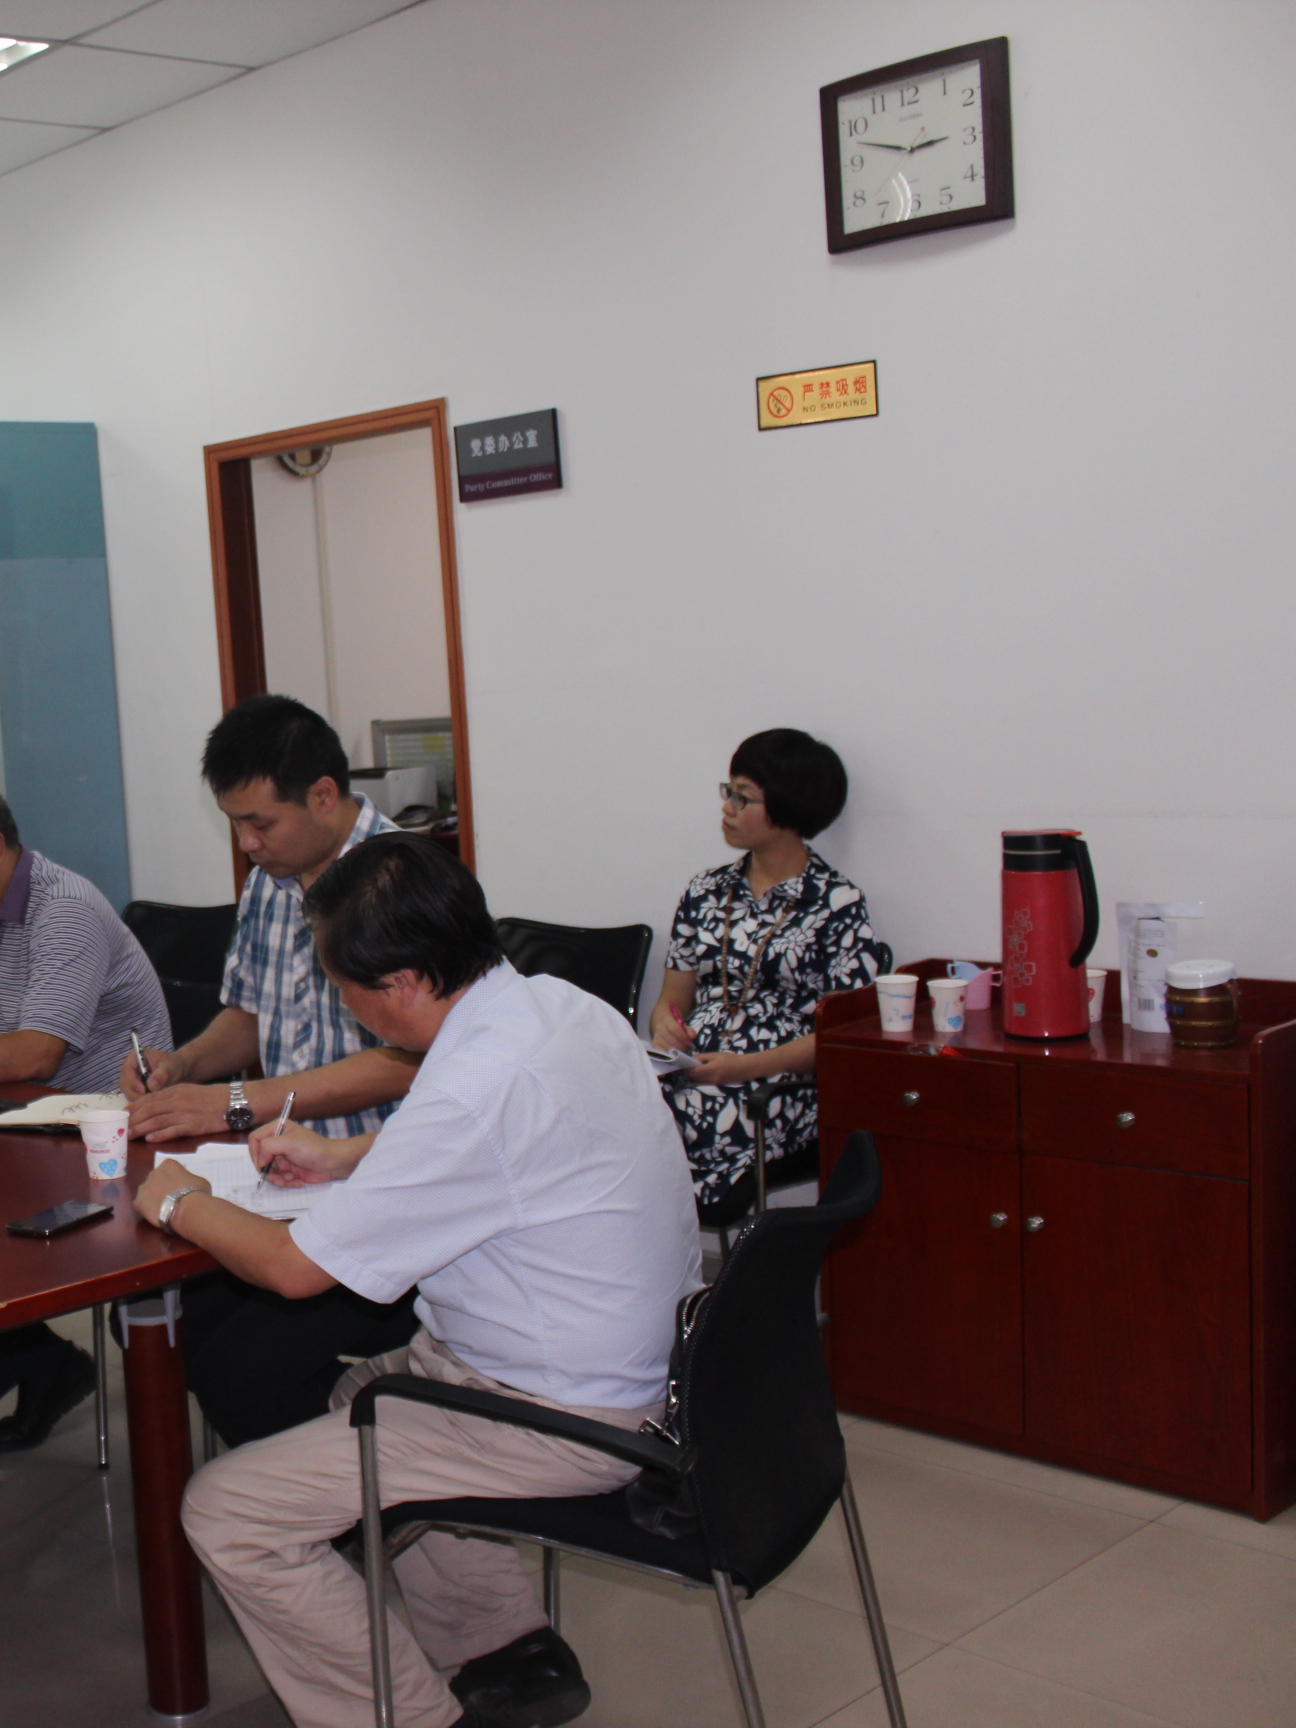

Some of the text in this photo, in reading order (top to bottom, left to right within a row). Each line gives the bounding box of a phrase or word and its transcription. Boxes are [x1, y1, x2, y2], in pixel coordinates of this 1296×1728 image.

[899, 85, 920, 107] 12
[942, 78, 947, 96] 1
[962, 87, 975, 107] 2
[871, 93, 886, 114] 11
[847, 116, 869, 137] 10
[962, 126, 977, 145] 3
[850, 154, 865, 173] 9
[963, 163, 978, 182] 4
[852, 189, 866, 208] 8
[939, 186, 953, 206] 5
[877, 201, 890, 219] 7
[802, 375, 868, 402] 严禁吸烟
[802, 398, 868, 413] NO SMOKING
[470, 428, 539, 458] 党委办公室
[465, 483, 485, 493] Party
[529, 472, 554, 483] Office
